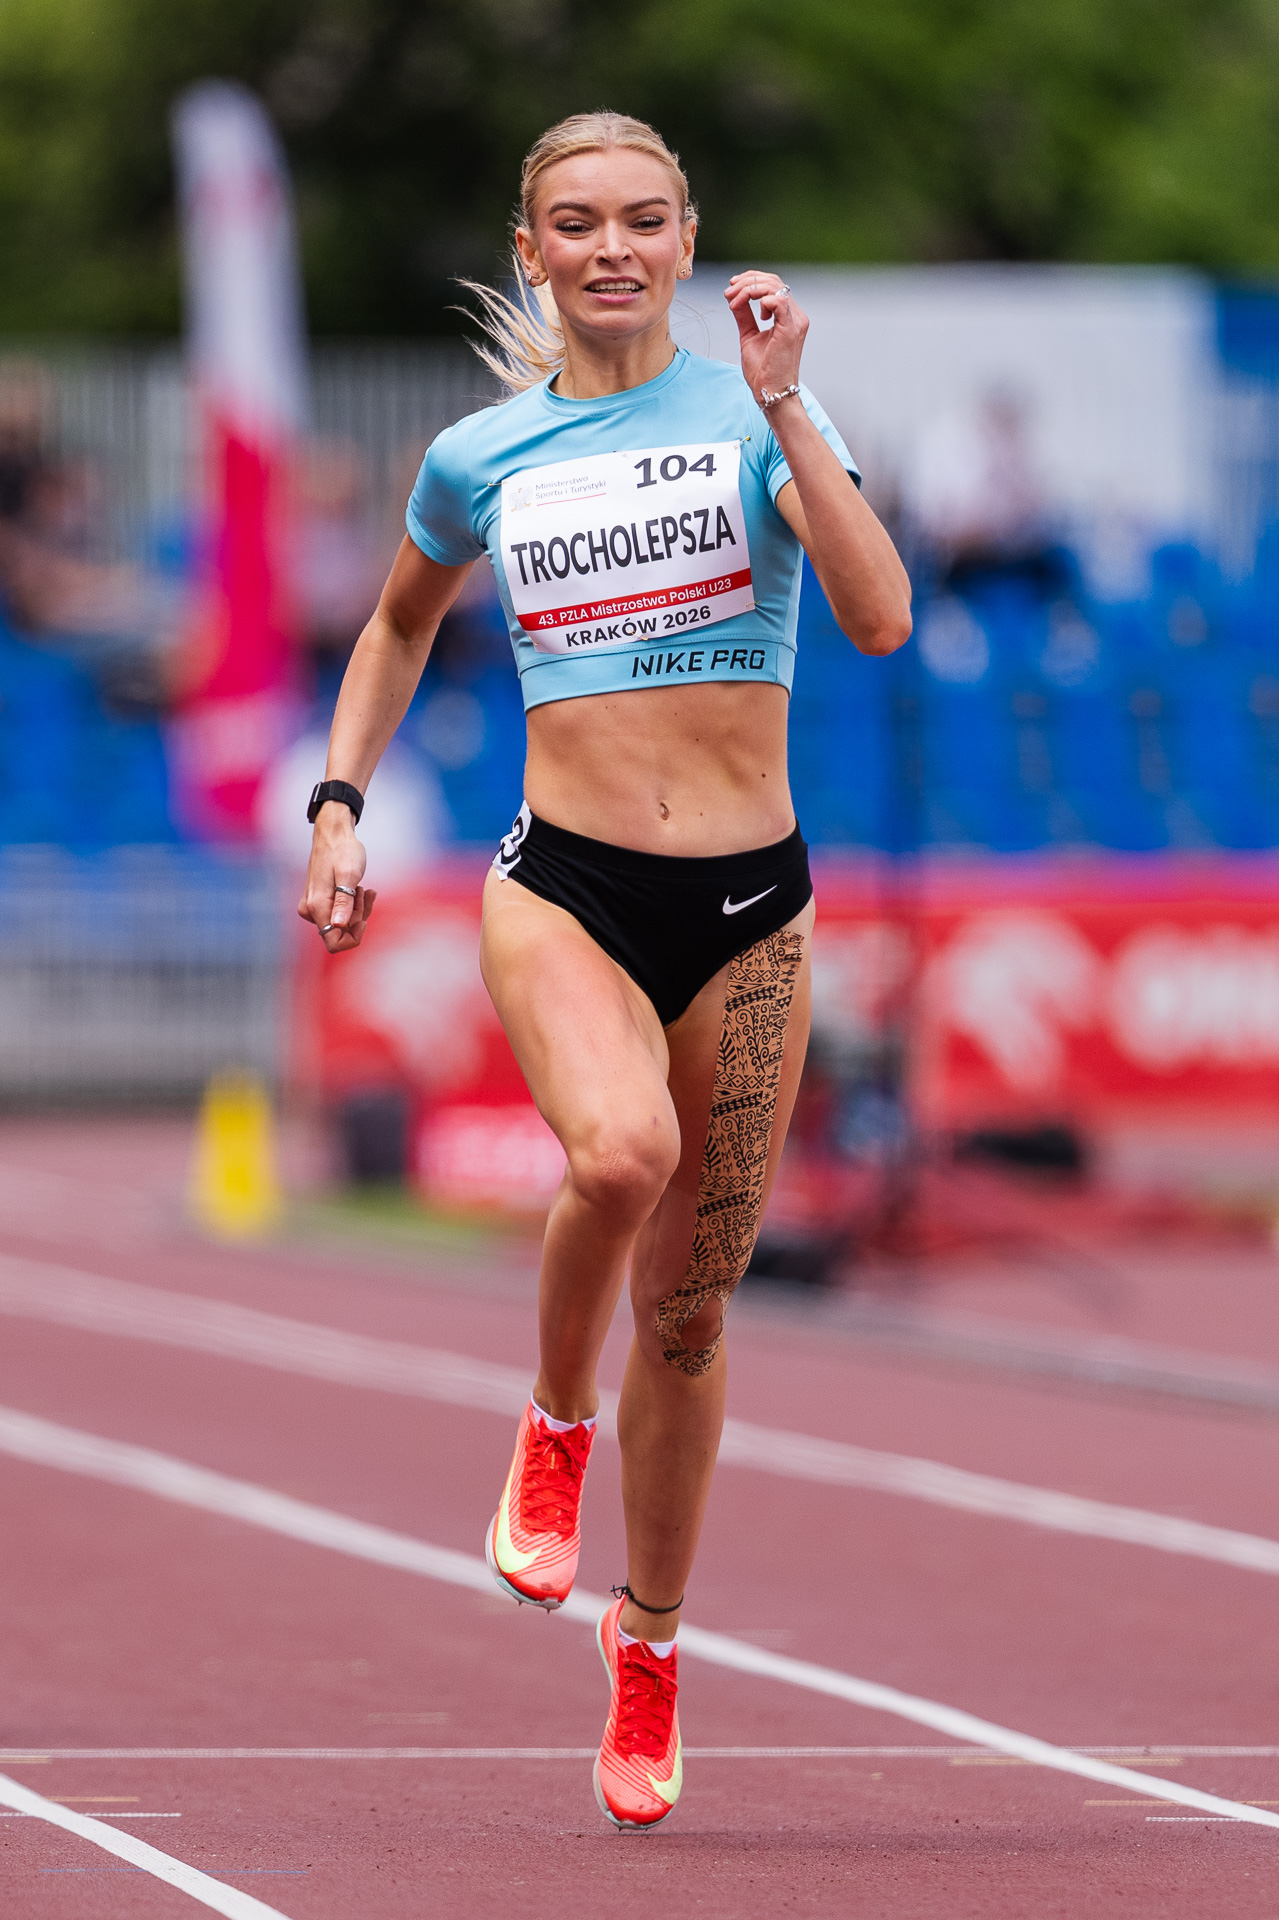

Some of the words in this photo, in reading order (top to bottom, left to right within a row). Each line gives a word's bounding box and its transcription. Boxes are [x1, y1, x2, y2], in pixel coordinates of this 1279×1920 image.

[535, 475, 589, 491] Ministerstwo
[633, 453, 717, 489] 104
[535, 489, 563, 500] Sportu
[570, 480, 606, 494] Turystyki
[510, 505, 737, 586] TROCHOLEPSZA
[538, 614, 558, 626] 43.
[560, 610, 589, 624] PZLA
[590, 593, 667, 618] Mistrzostwa
[669, 584, 707, 600] Polski
[709, 578, 732, 593] U23
[565, 617, 658, 648] KRAKÓW
[662, 605, 712, 630] 2026
[631, 650, 705, 678] NIKE
[710, 649, 766, 670] PRO
